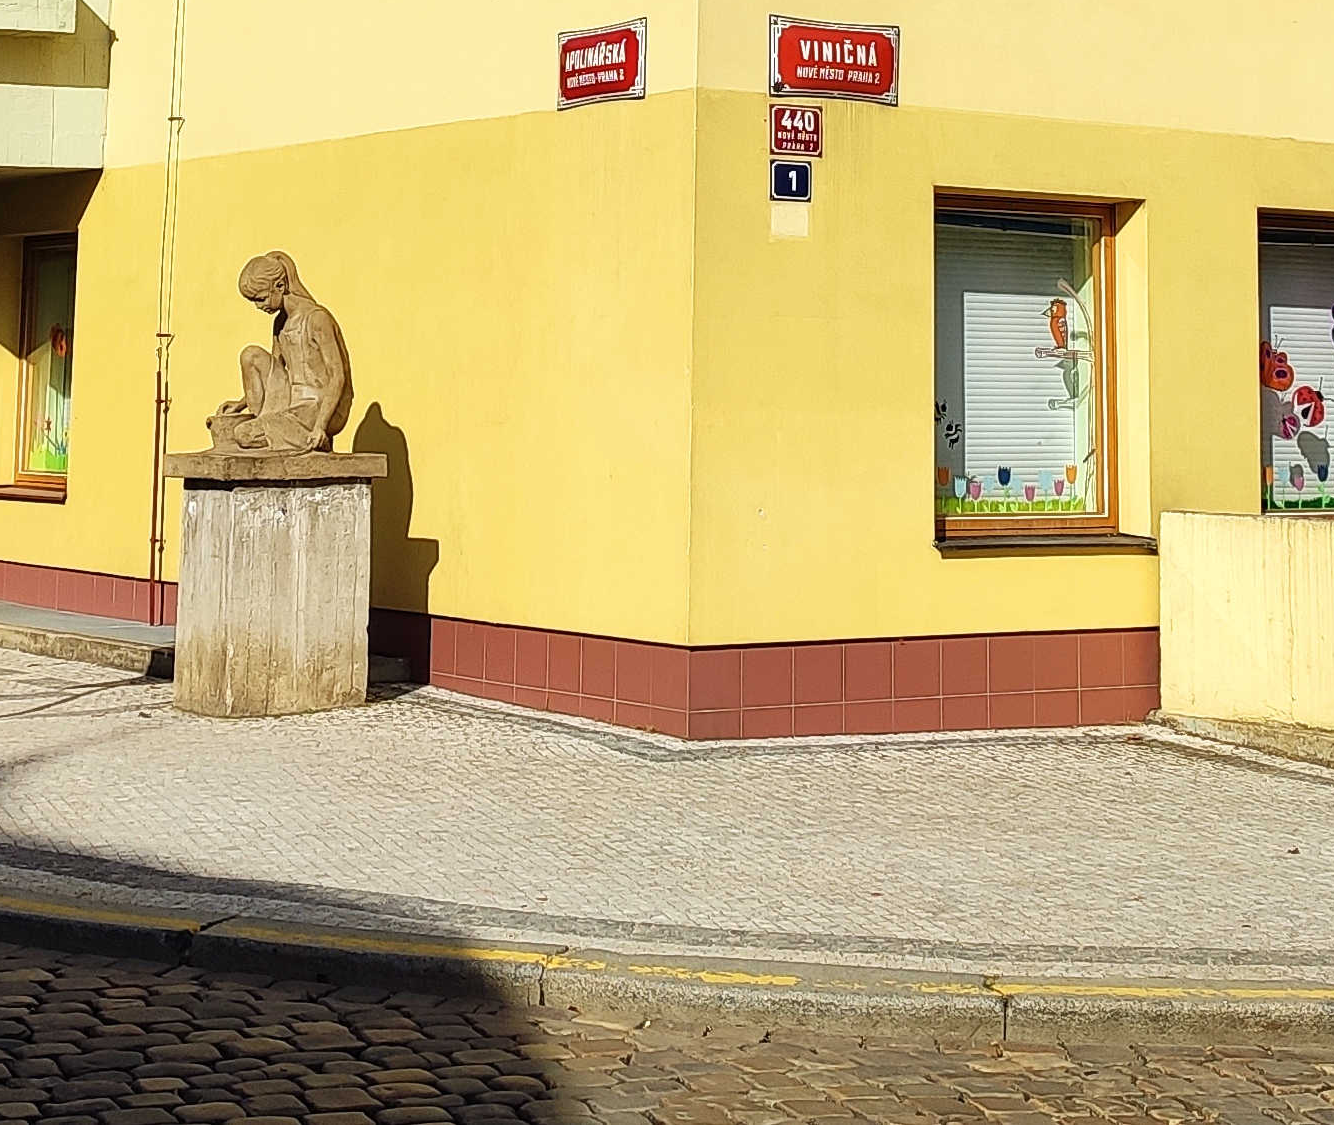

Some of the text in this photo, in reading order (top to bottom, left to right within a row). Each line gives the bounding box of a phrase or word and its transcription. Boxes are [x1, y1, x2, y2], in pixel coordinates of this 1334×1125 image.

[565, 38, 627, 72] APOLINÁŘSKÁ
[800, 39, 877, 66] VINIČNÁ
[619, 69, 624, 80] 2
[796, 65, 880, 84] NOVÉ MĚSTO PRAHA 2
[781, 109, 815, 132] 440
[788, 170, 797, 192] 1
